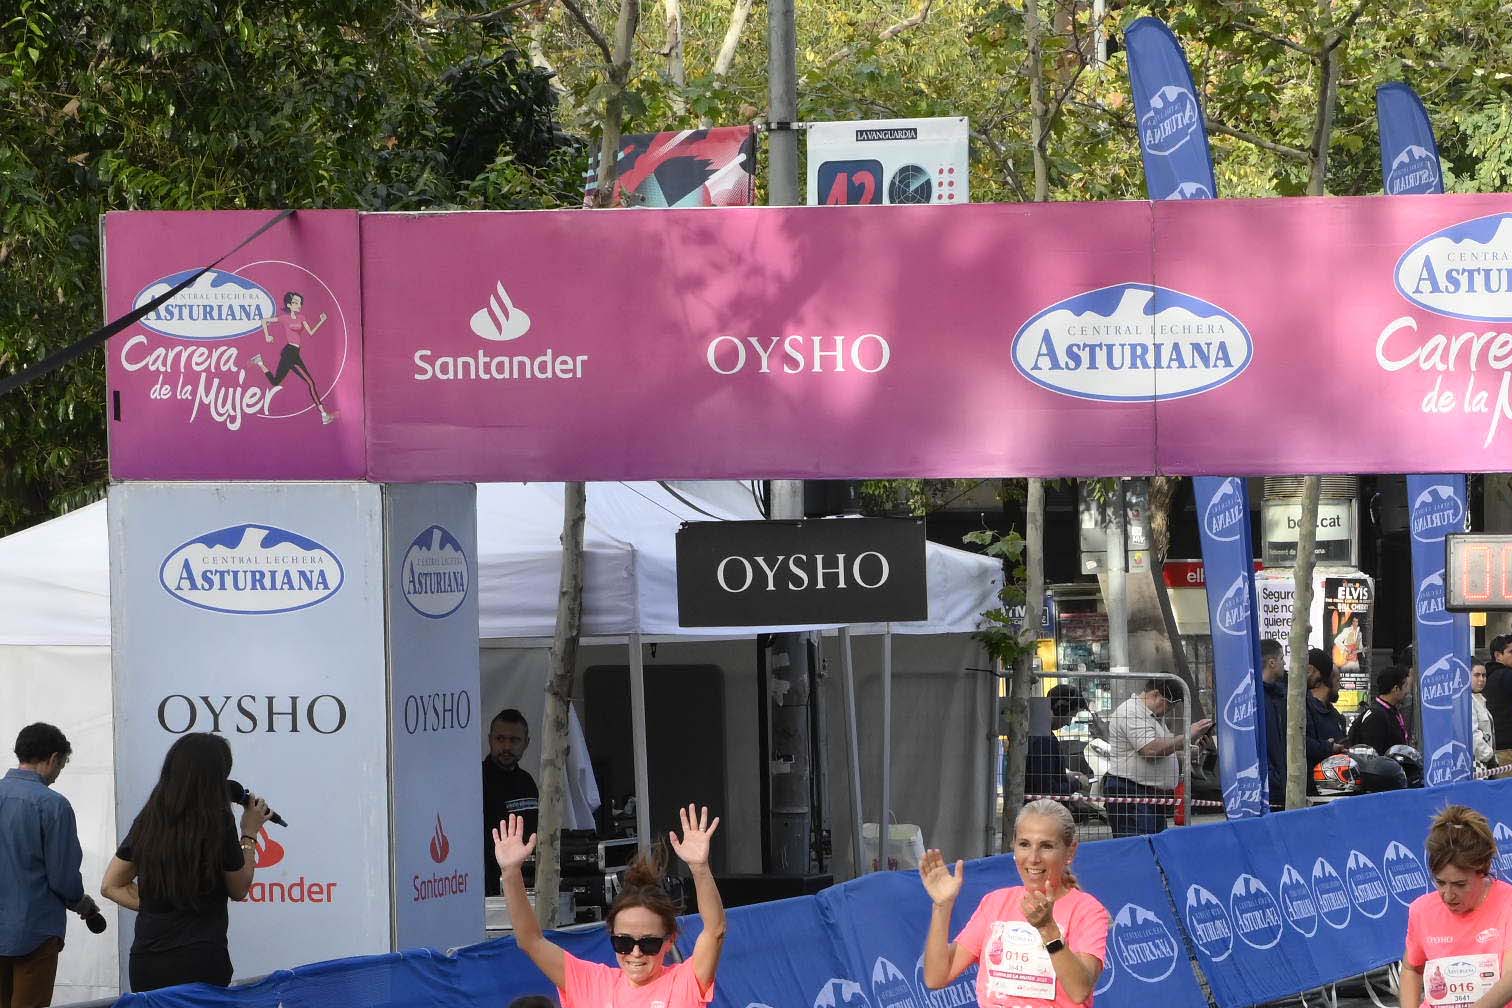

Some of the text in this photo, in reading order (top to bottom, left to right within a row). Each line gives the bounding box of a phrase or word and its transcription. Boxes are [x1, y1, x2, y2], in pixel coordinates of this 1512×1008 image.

[868, 129, 917, 139] VANGUARDIA
[174, 292, 211, 300] ENTRAL
[1067, 324, 1226, 335] CENTRAL LECHERA
[121, 335, 238, 372] Carrera
[413, 349, 588, 380] Santander
[706, 334, 891, 375] OYSHO
[1030, 328, 1234, 373] ASTURIANA
[150, 368, 283, 431] de la Mujer
[1421, 374, 1456, 413] de
[1464, 373, 1488, 413] la
[1287, 513, 1341, 530] b.cat
[175, 558, 331, 592] ASTURIANA
[202, 555, 325, 565] CENTRAL LECHERA
[717, 551, 889, 593] OYSHO
[406, 564, 465, 597] ASTURIANA
[1187, 571, 1205, 583] el
[1338, 587, 1368, 600] ELVIS
[1264, 616, 1294, 629] quiere
[157, 694, 347, 735] OYSHO
[404, 690, 471, 735] OYSHO
[246, 877, 337, 903] ander
[413, 870, 469, 902] Santander
[1005, 950, 1030, 962] 016
[1449, 982, 1475, 992] 016
